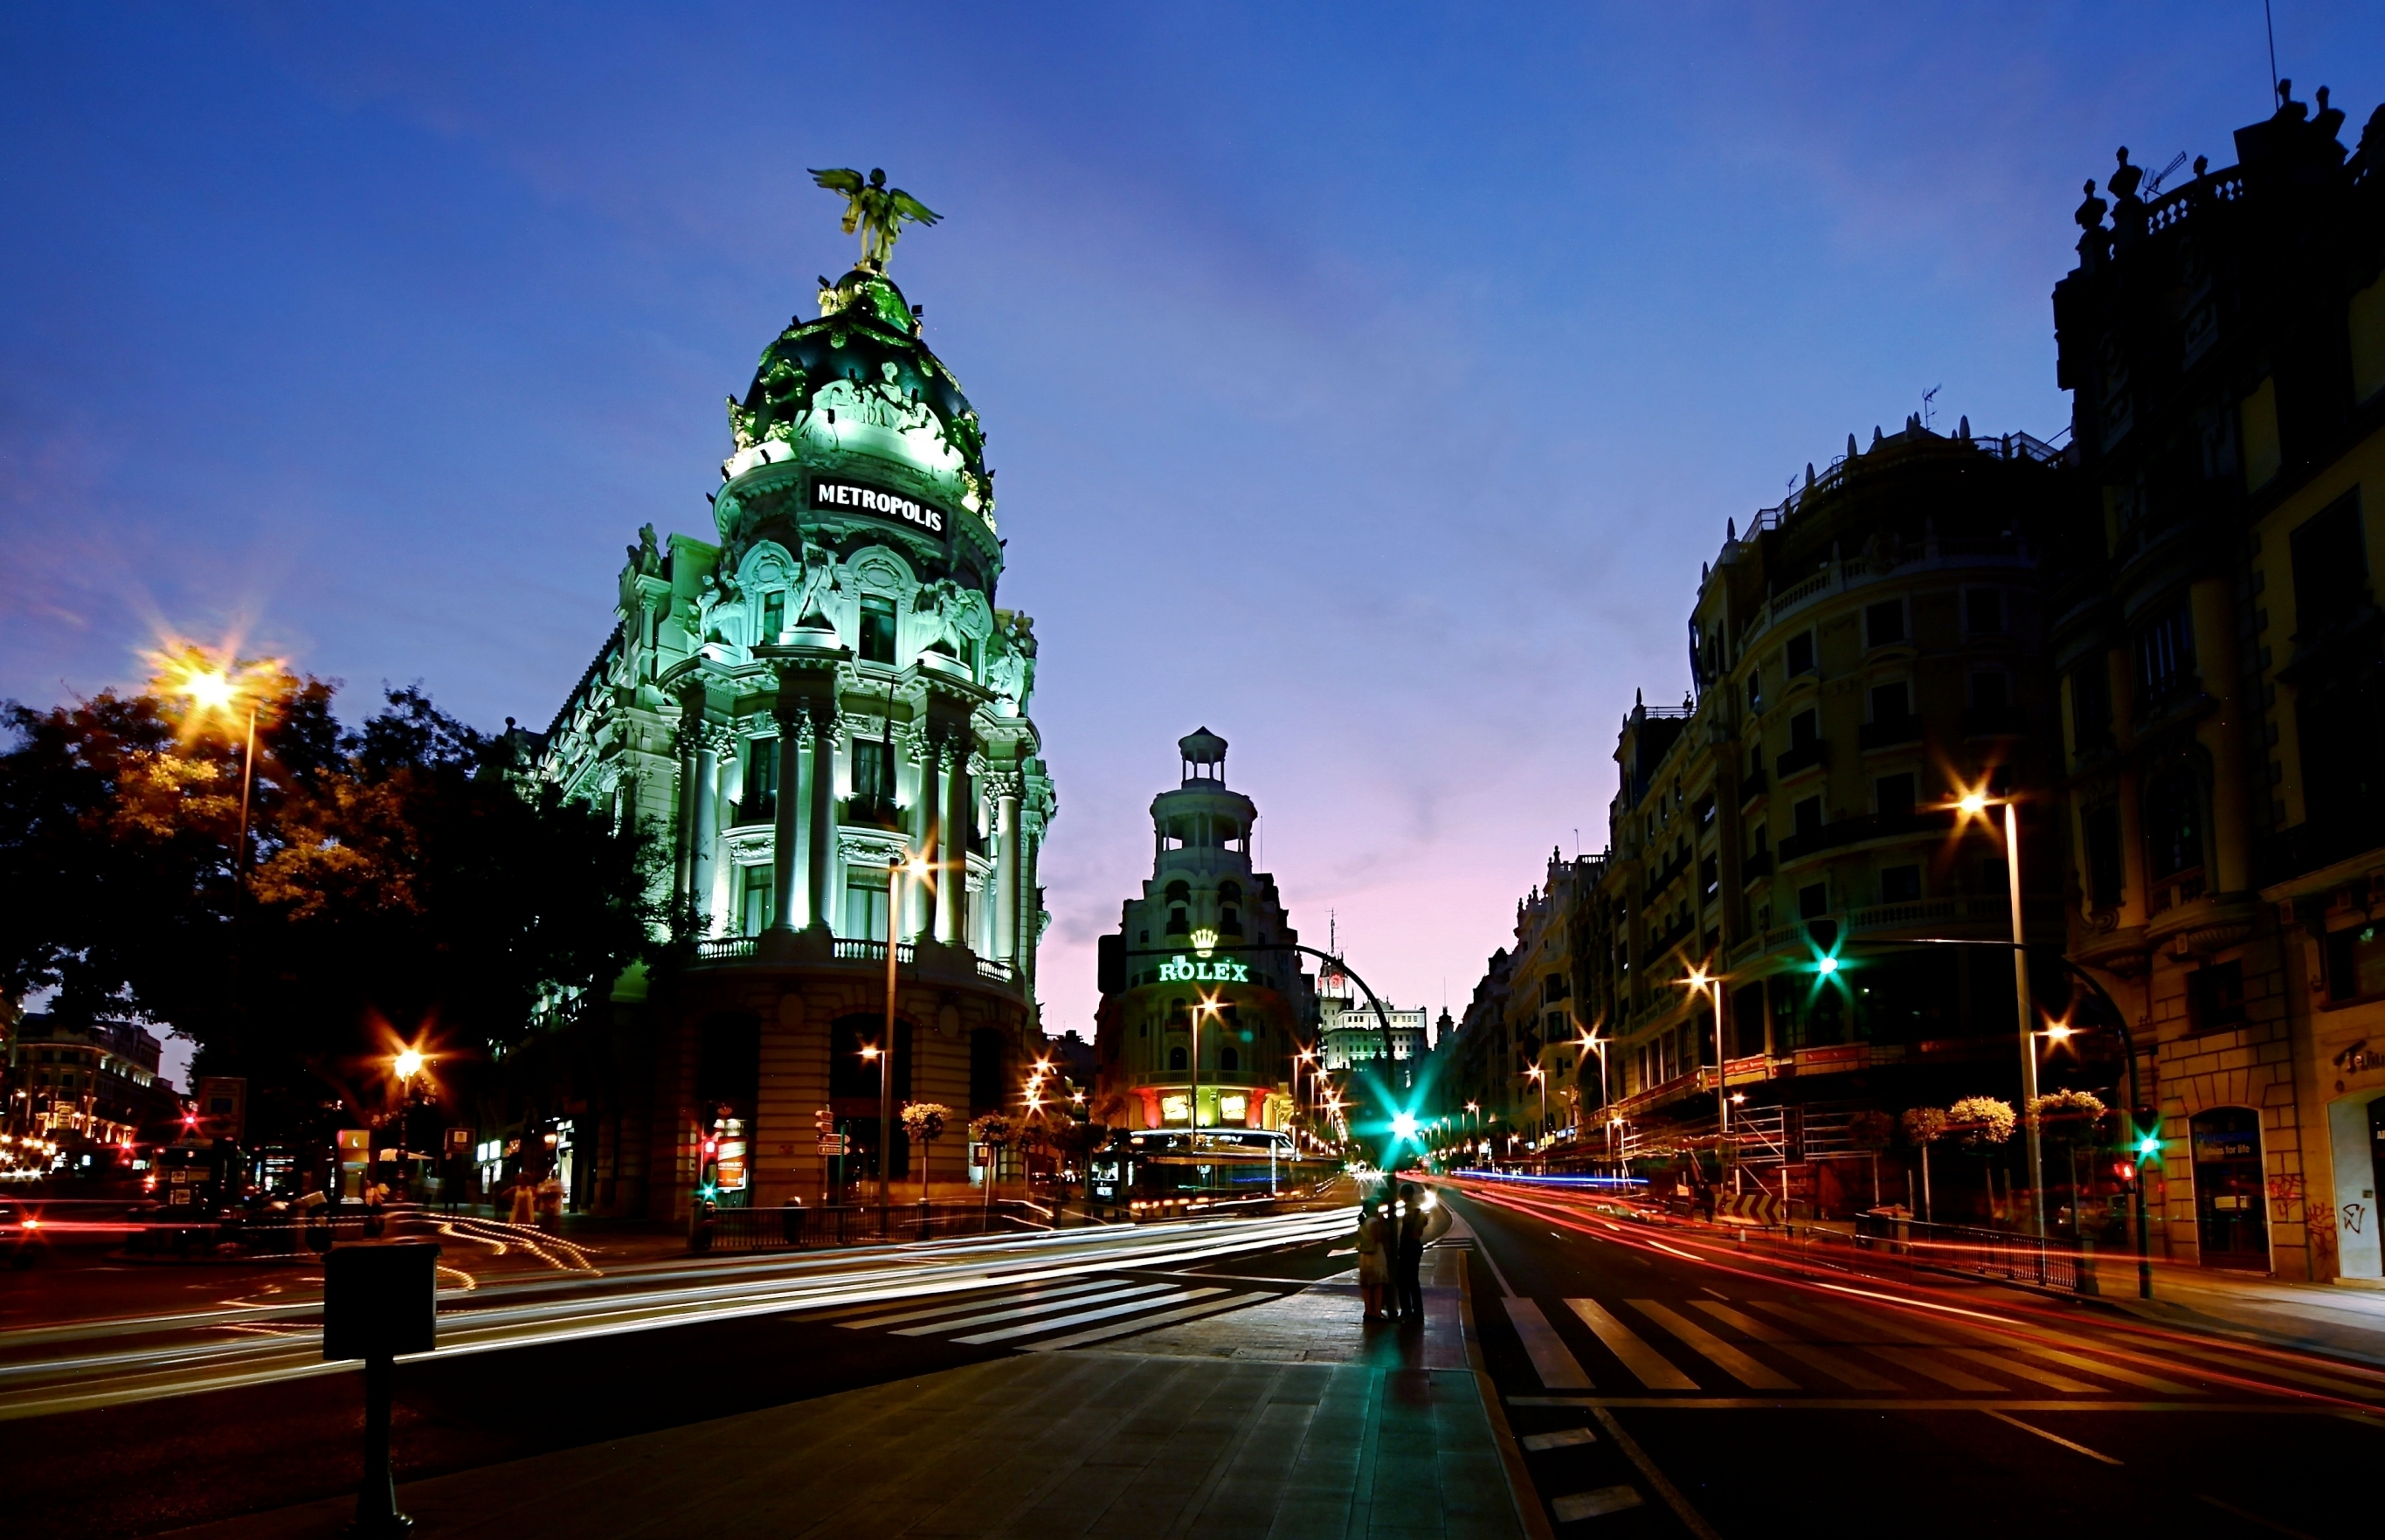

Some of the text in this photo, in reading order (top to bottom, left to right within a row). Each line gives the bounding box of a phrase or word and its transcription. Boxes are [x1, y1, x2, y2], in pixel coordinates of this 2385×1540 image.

[819, 484, 942, 532] METROPOLIS
[1158, 962, 1249, 983] ROLEX
[2225, 1144, 2236, 1155] for
[2237, 1143, 2250, 1154] life
